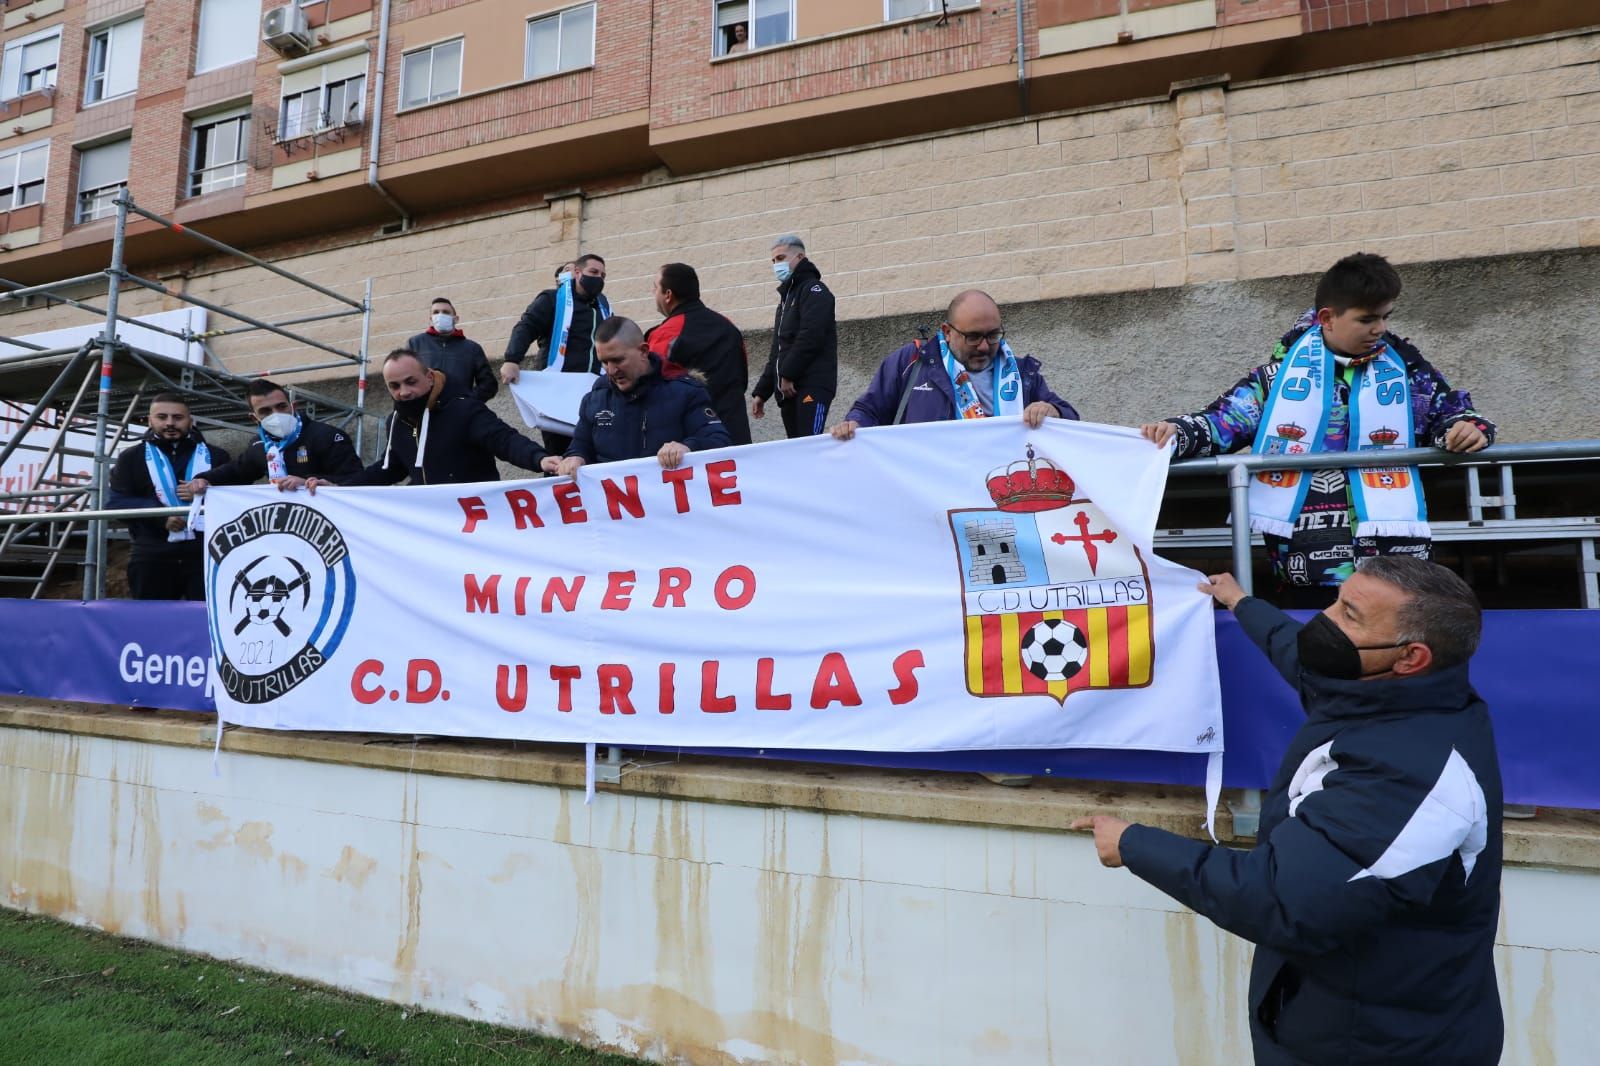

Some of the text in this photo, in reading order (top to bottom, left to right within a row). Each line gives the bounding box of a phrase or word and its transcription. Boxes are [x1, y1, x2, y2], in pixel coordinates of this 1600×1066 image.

[457, 459, 743, 533] FRENTE
[210, 504, 347, 568] FRENTE MINERO
[464, 565, 757, 616] MINERO
[978, 580, 1145, 612] C.D. UTRILLAS
[239, 640, 274, 665] 2021
[241, 648, 323, 703] UTRILLAS
[350, 649, 925, 715] C.D. UTRILLAS
